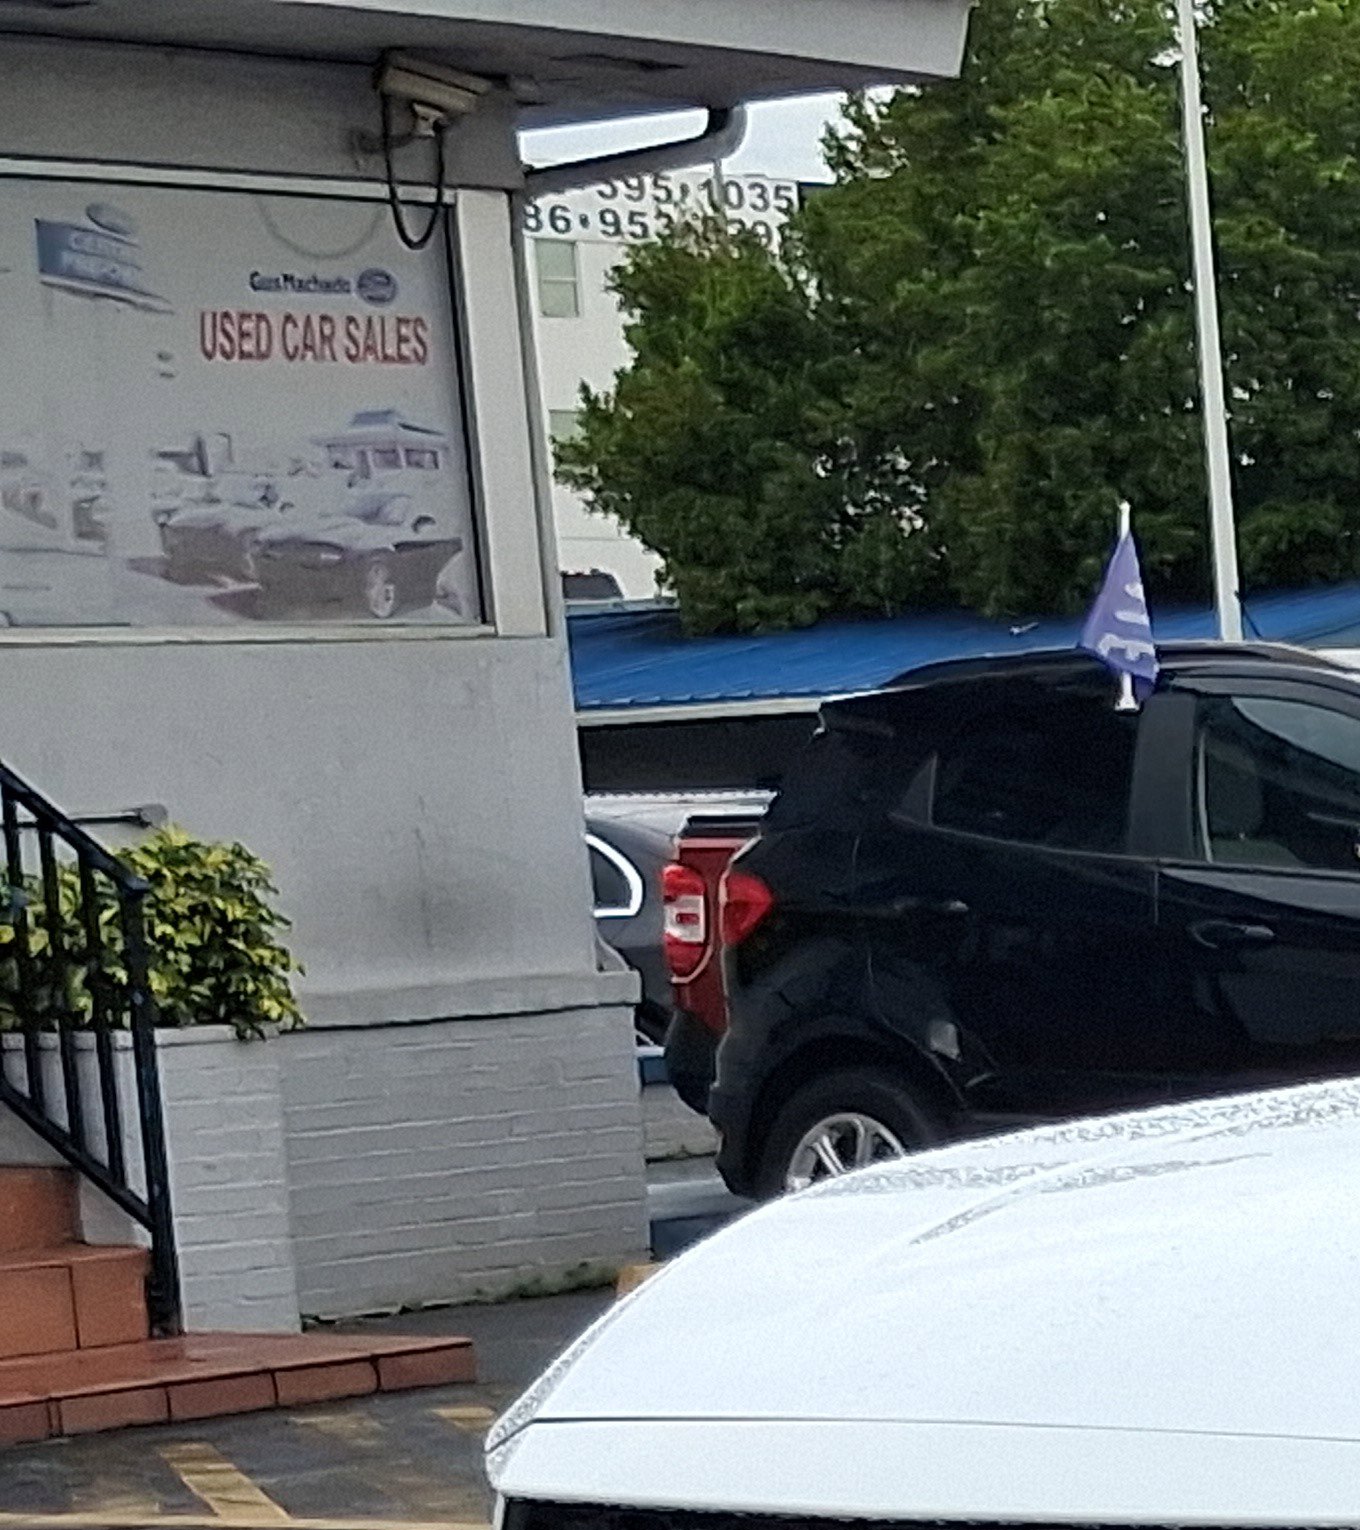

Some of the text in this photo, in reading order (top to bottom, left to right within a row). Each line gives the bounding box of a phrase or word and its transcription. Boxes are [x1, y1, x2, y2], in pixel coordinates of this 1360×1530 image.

[201, 310, 429, 366] USED CAR SALES
